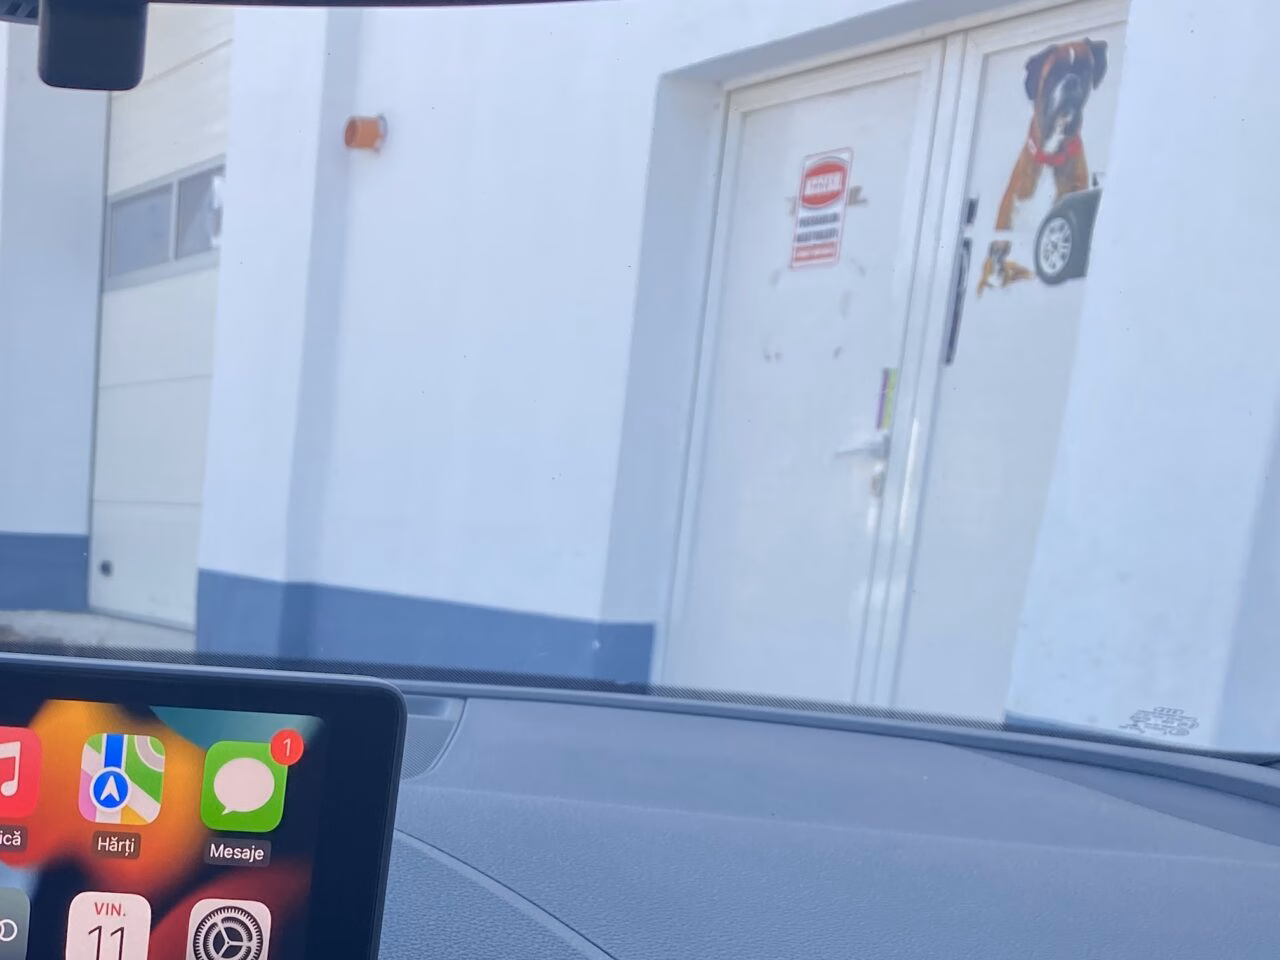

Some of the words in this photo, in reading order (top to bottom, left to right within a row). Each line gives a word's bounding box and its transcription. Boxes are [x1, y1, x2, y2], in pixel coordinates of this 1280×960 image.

[282, 738, 292, 757] 1
[209, 843, 265, 861] Mesaje
[94, 901, 127, 917] VIN.
